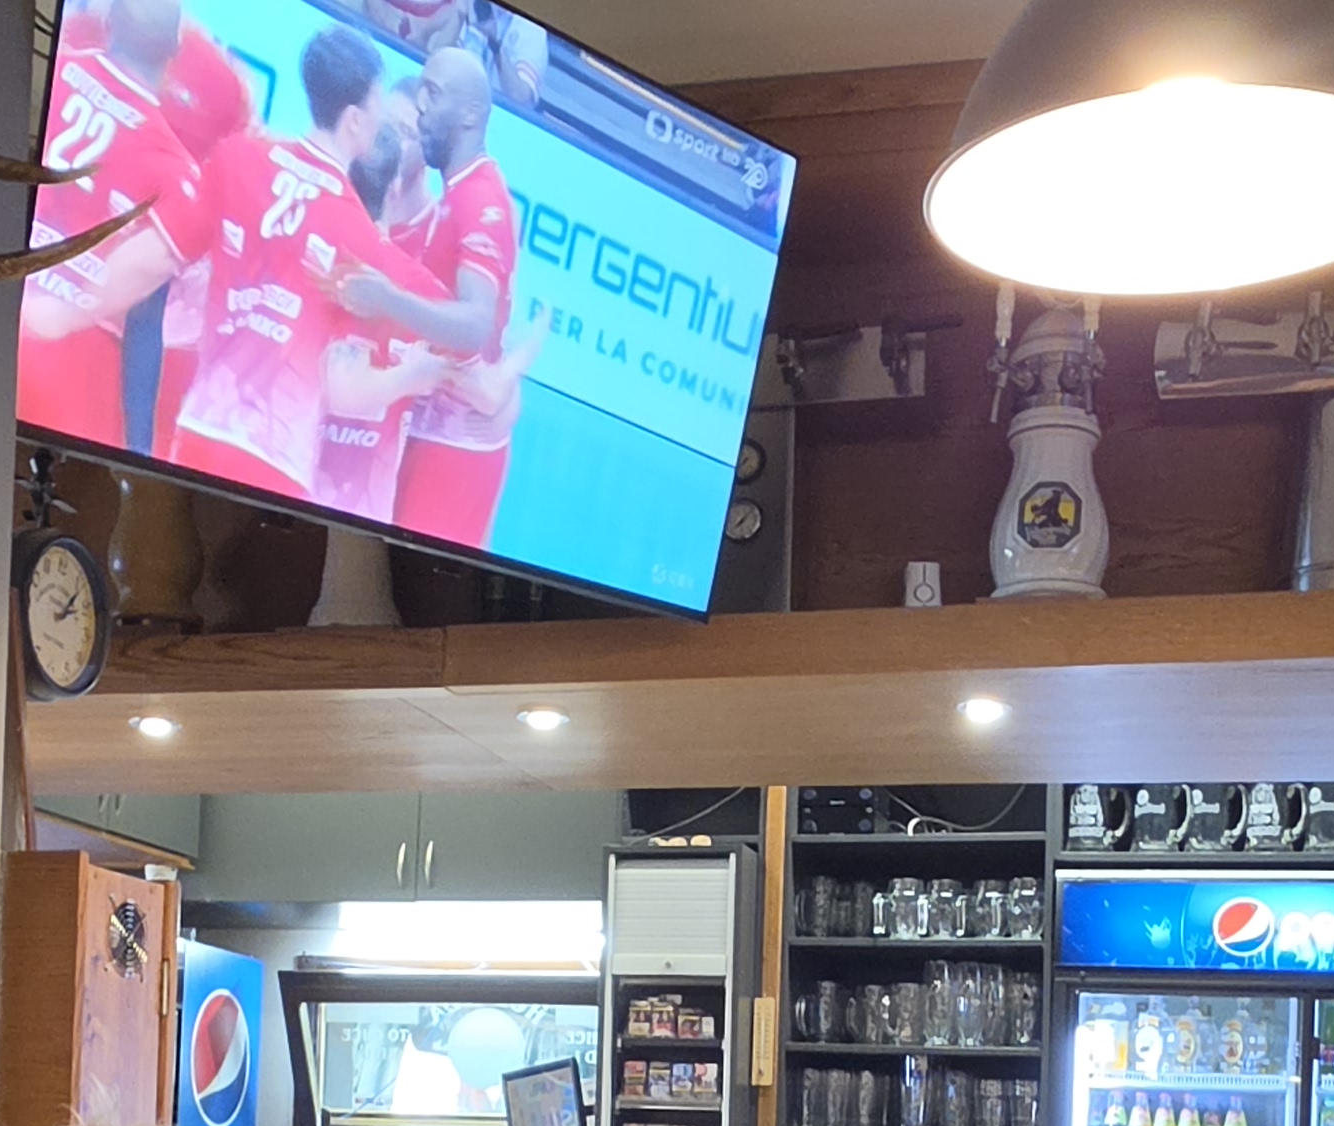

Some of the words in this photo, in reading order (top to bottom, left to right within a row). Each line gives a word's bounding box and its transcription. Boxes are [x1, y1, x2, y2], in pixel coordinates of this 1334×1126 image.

[673, 129, 719, 162] sport
[528, 297, 584, 344] PER
[595, 328, 627, 364] LA
